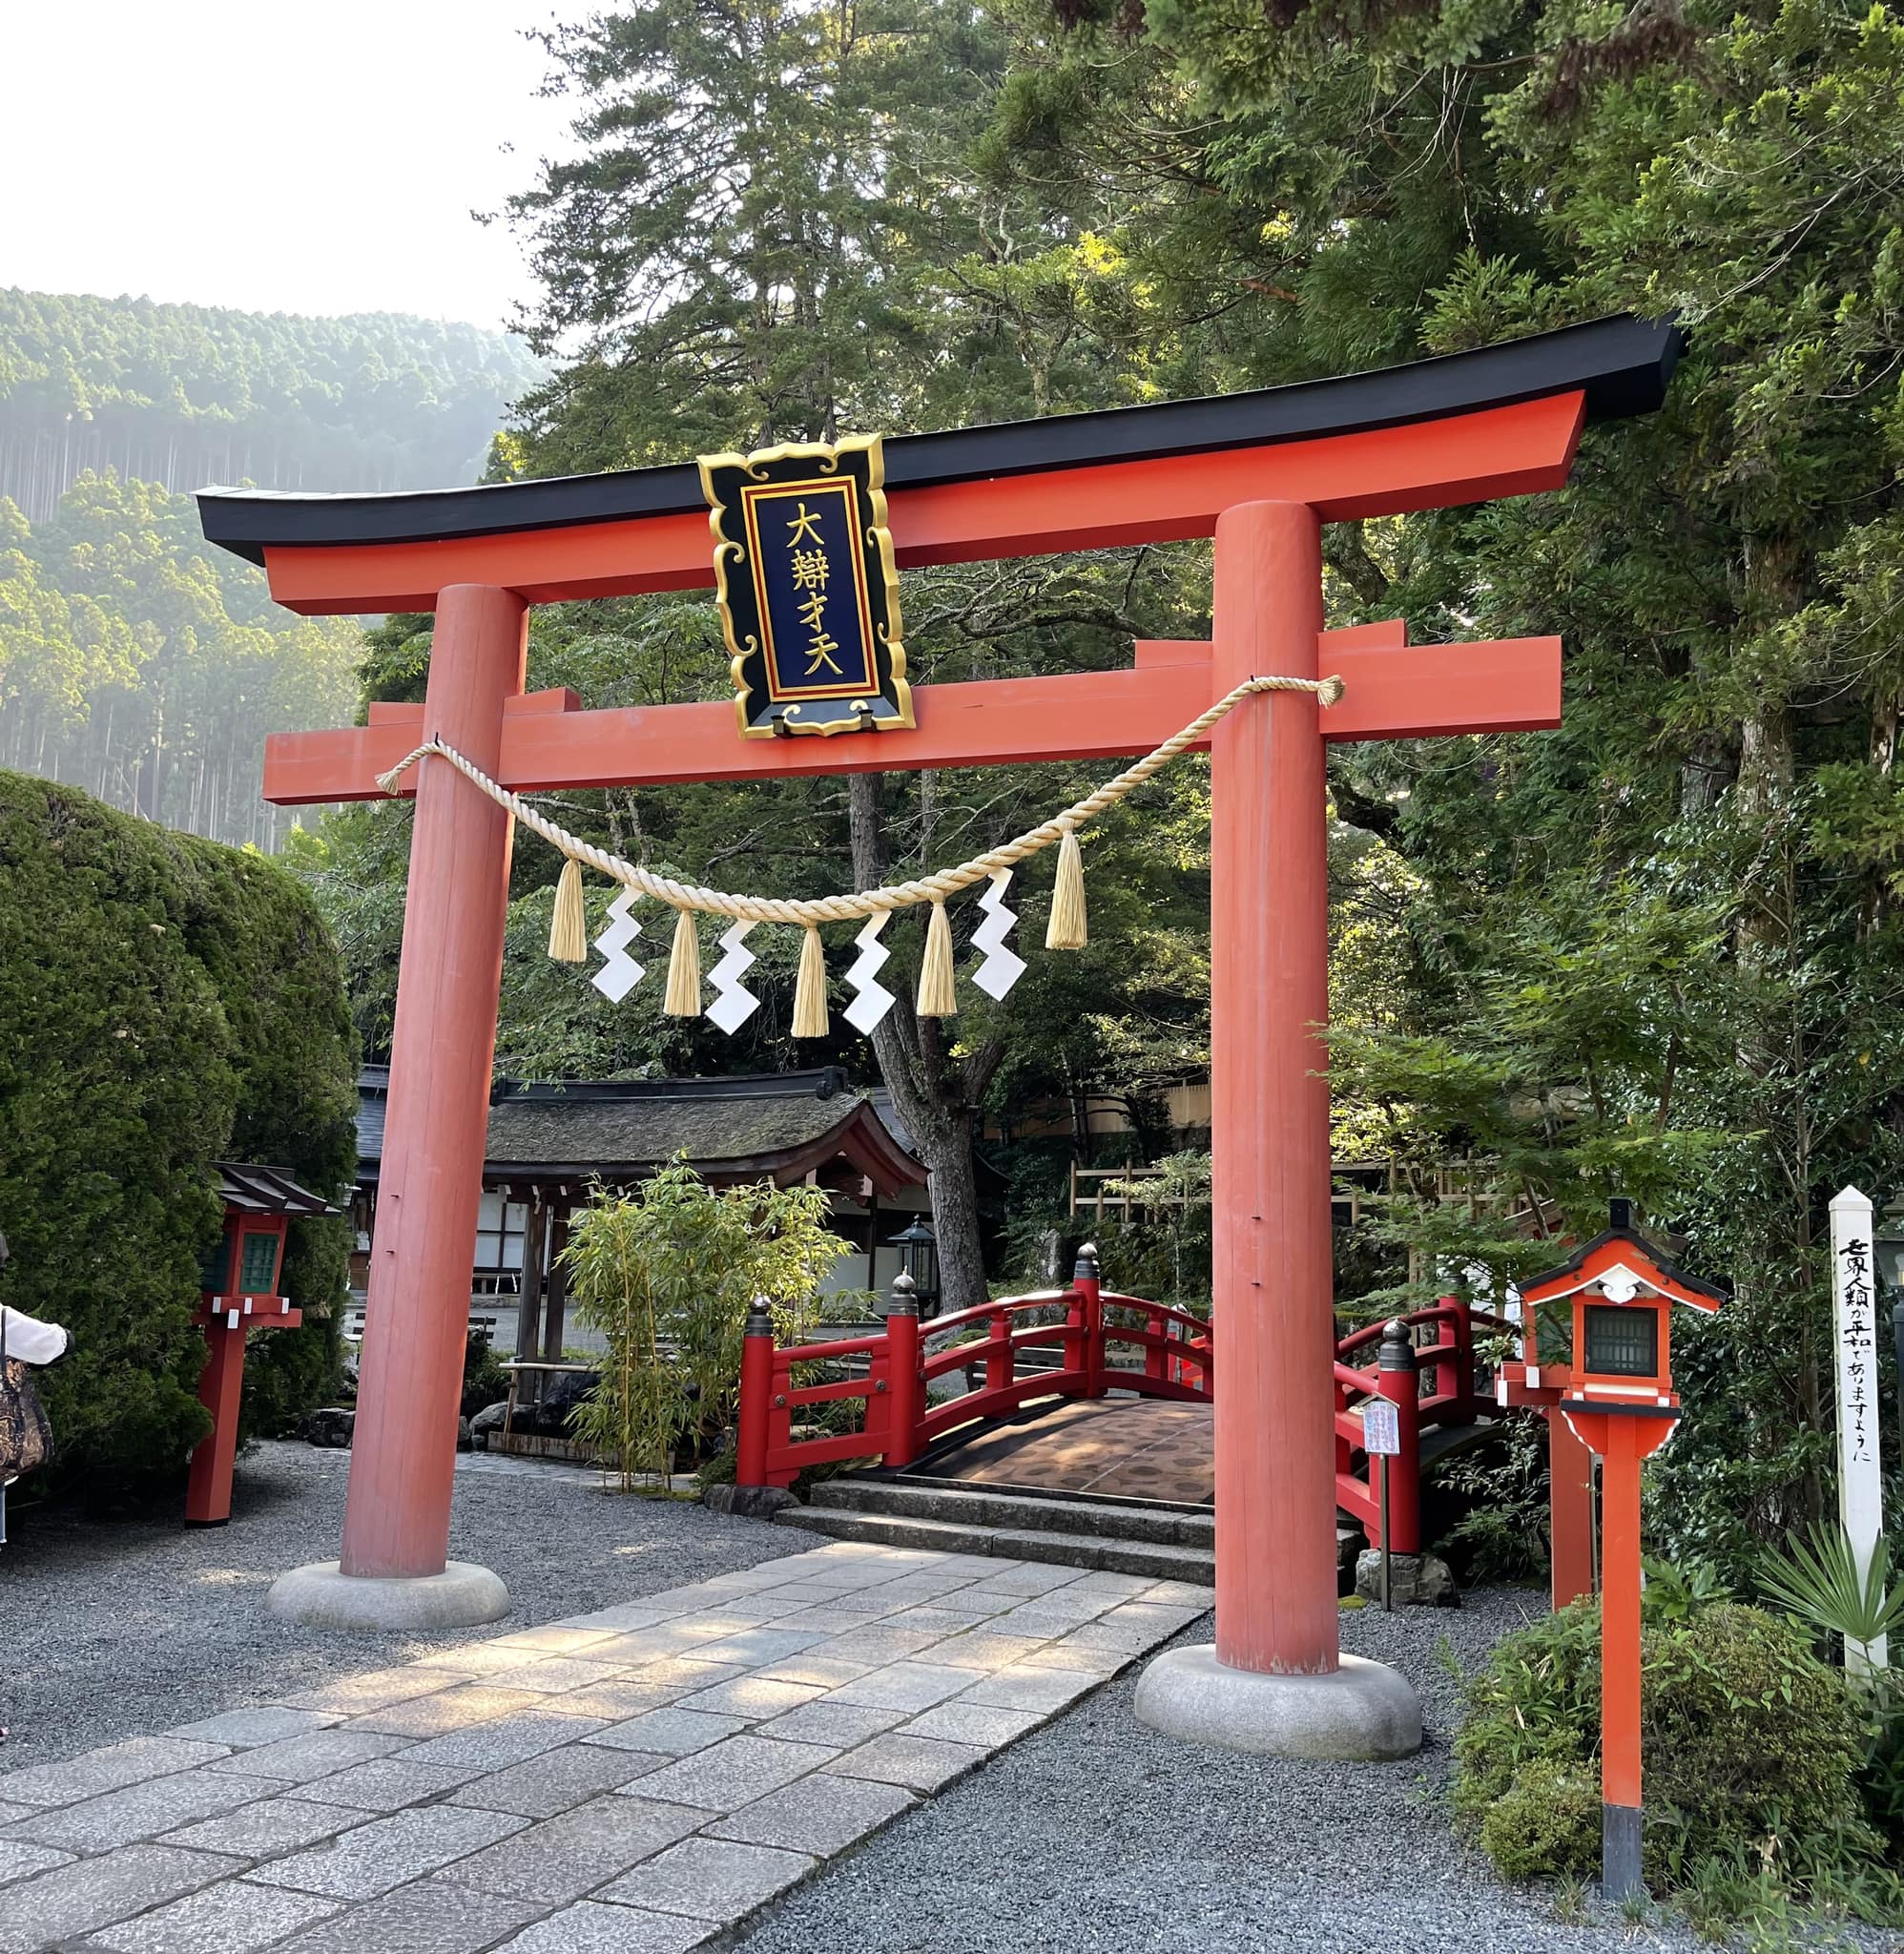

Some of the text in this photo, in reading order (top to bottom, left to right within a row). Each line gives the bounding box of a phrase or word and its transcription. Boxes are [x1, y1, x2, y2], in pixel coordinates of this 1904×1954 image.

[786, 502, 843, 676] 大辯才天
[1838, 1238, 1873, 1462] 世界人類が平和でありますように
